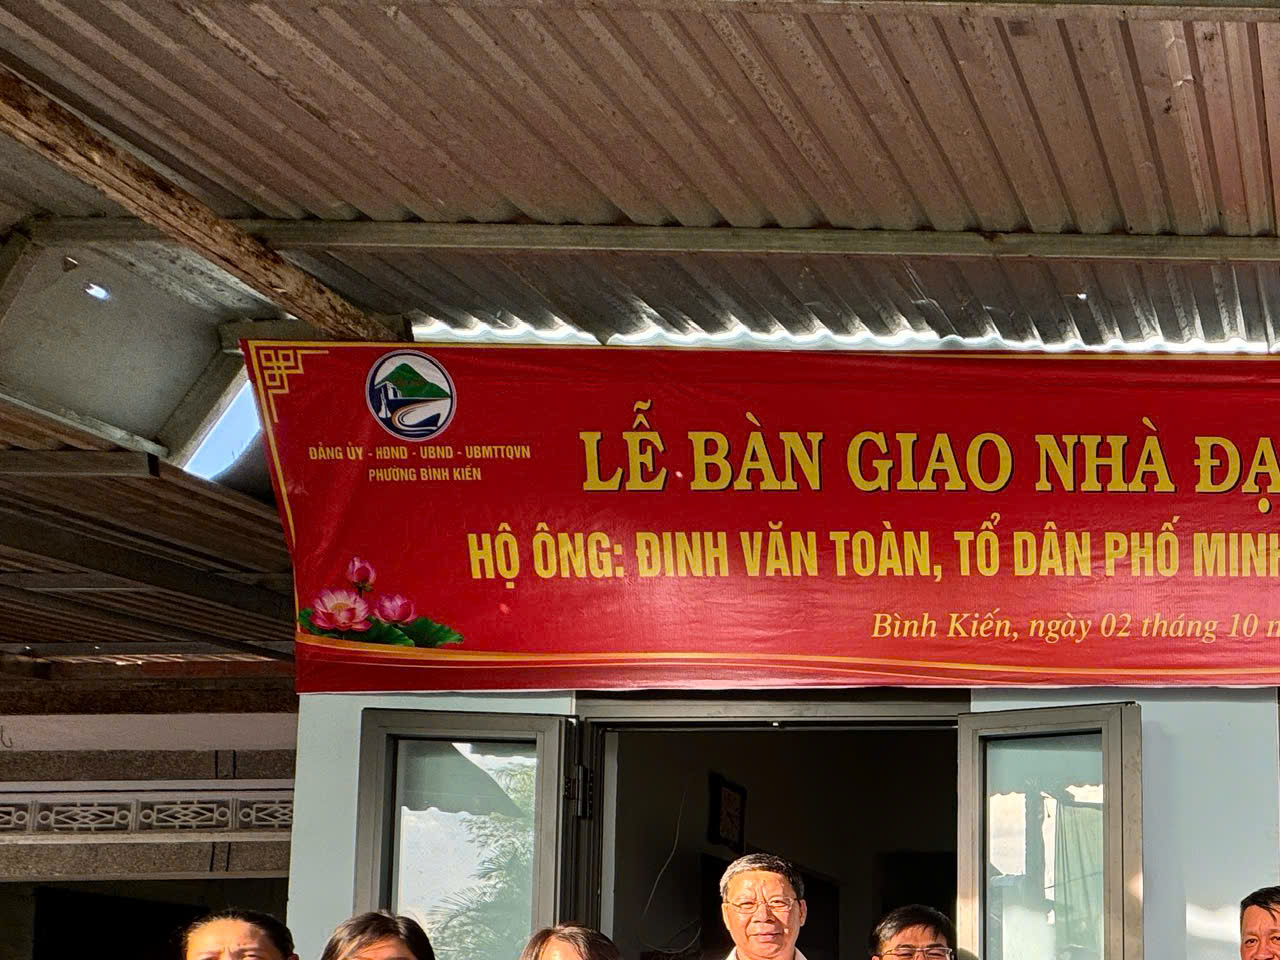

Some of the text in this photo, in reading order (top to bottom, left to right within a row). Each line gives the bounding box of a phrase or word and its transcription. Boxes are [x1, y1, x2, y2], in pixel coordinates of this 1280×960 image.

[309, 442, 344, 460] ĐẢNG
[376, 446, 408, 460] HĐND
[420, 446, 454, 459] UBND
[465, 445, 532, 460] UBMTTQVN
[579, 400, 667, 491] LỄ
[688, 411, 823, 491] BÀN
[847, 431, 1013, 492] GIAO
[1036, 416, 1175, 494] NHÀ
[368, 464, 482, 482] PHƯỜNG BÌNH KIẾN
[467, 522, 520, 589] HỘ
[533, 522, 624, 578] ÔNG:
[636, 530, 728, 578] ĐINH
[740, 521, 818, 577] VĂN
[830, 520, 943, 582] TOÀN,
[953, 512, 1000, 576] TỔ
[1014, 521, 1092, 577] DÂN
[1106, 516, 1180, 578] PHỐ
[871, 611, 938, 638] Bình
[946, 606, 1020, 642] Kiến,
[1029, 612, 1092, 643] ngày
[1100, 613, 1132, 638] 02
[1141, 612, 1219, 642] tháng
[1230, 613, 1258, 638] 10
